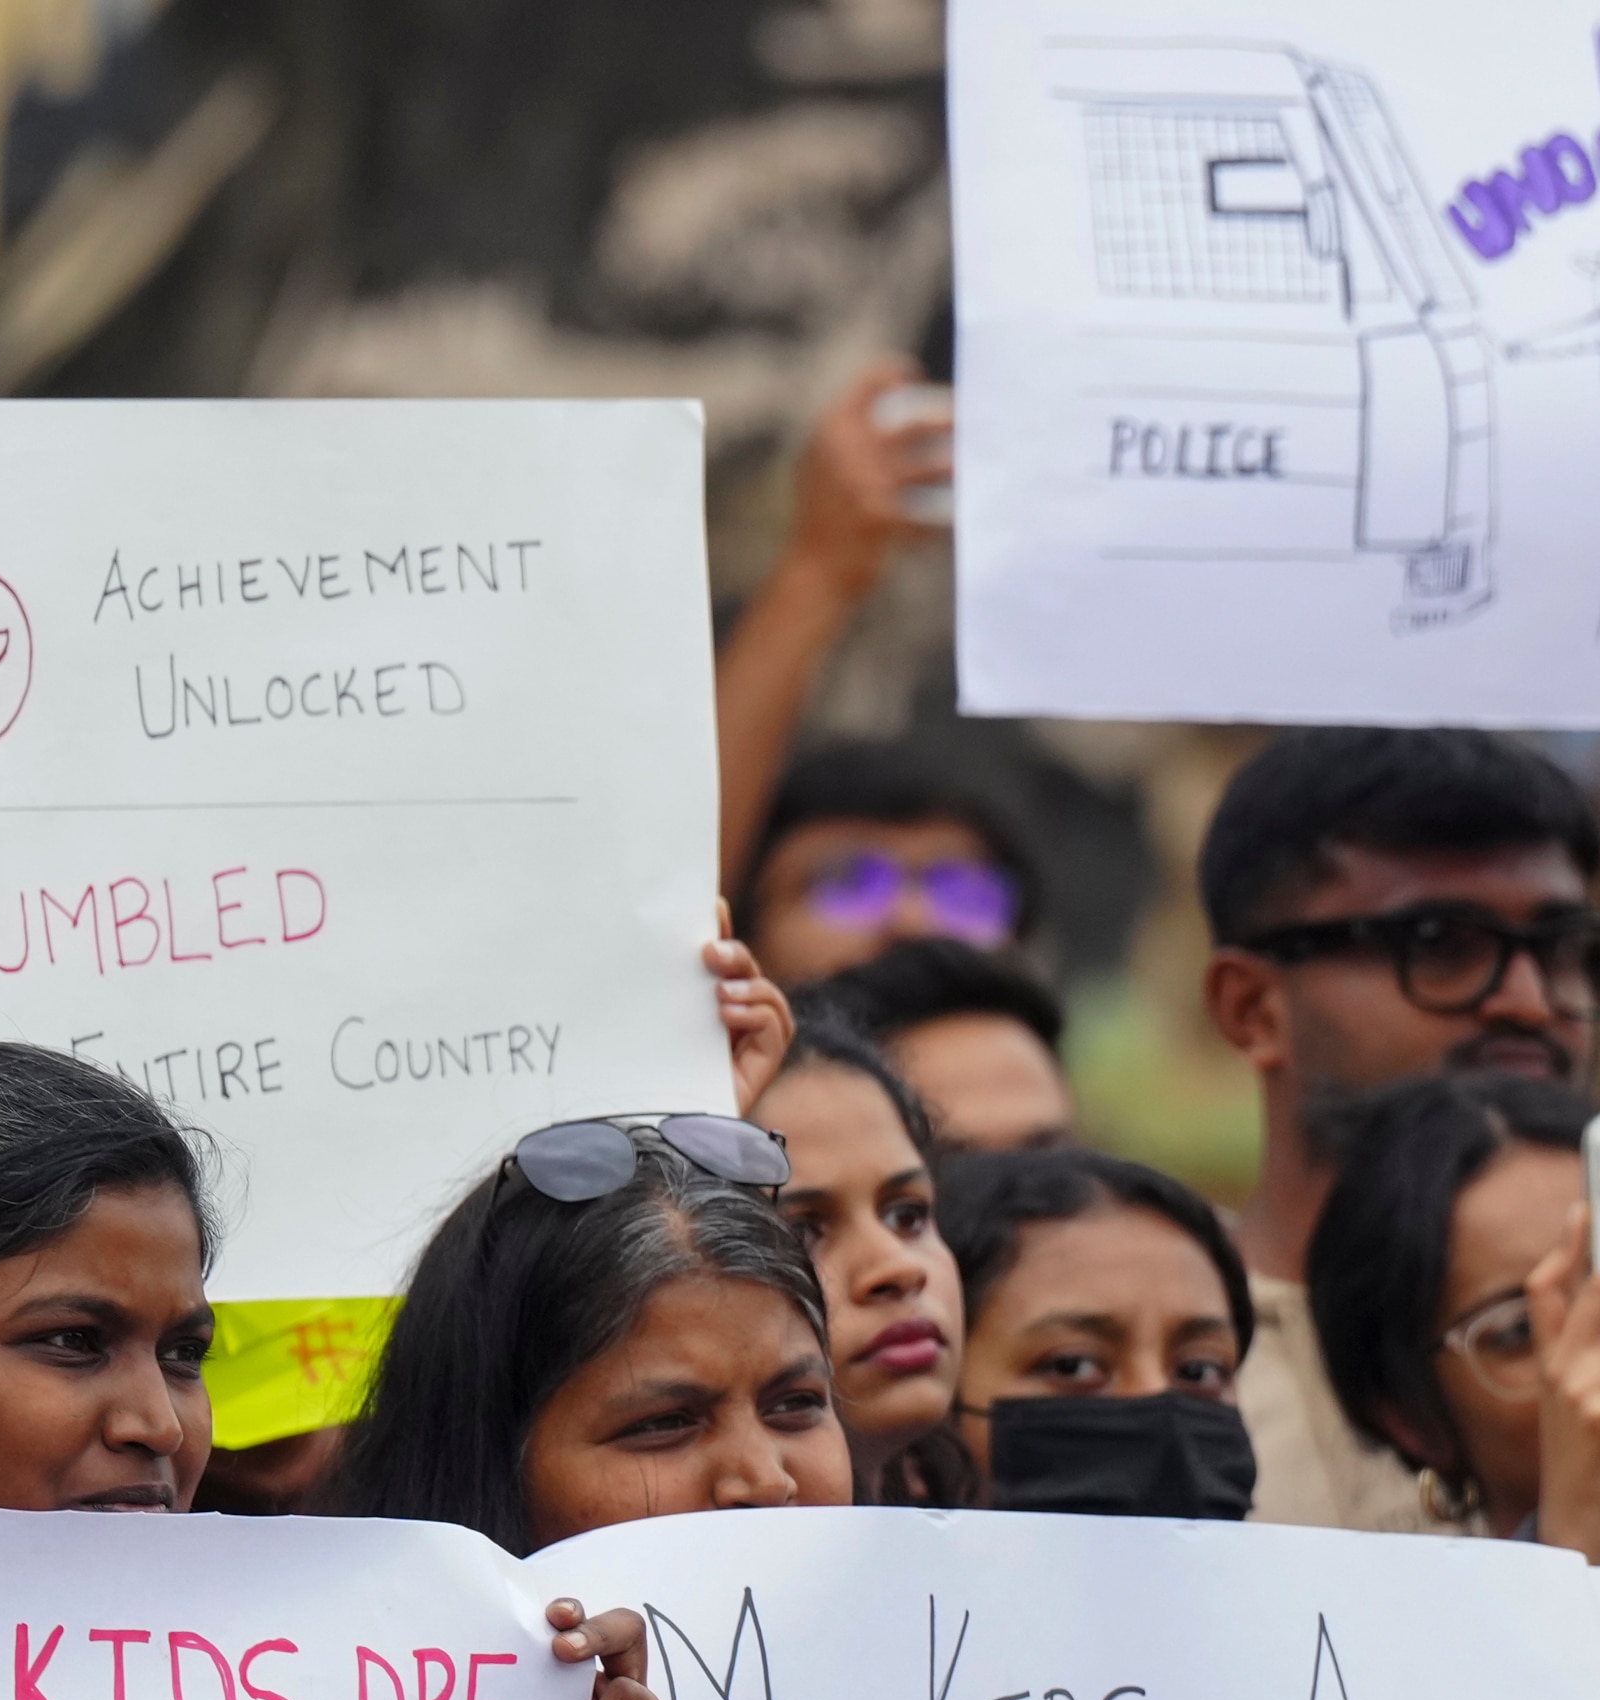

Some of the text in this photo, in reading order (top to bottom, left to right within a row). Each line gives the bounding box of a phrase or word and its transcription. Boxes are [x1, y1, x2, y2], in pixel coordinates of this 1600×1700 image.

[1108, 415, 1287, 480] POLICE
[92, 539, 543, 623] ACHIEVEMENT
[133, 652, 467, 740] UNLOCKED
[70, 1016, 561, 1101] NTIRE COUNTRY
